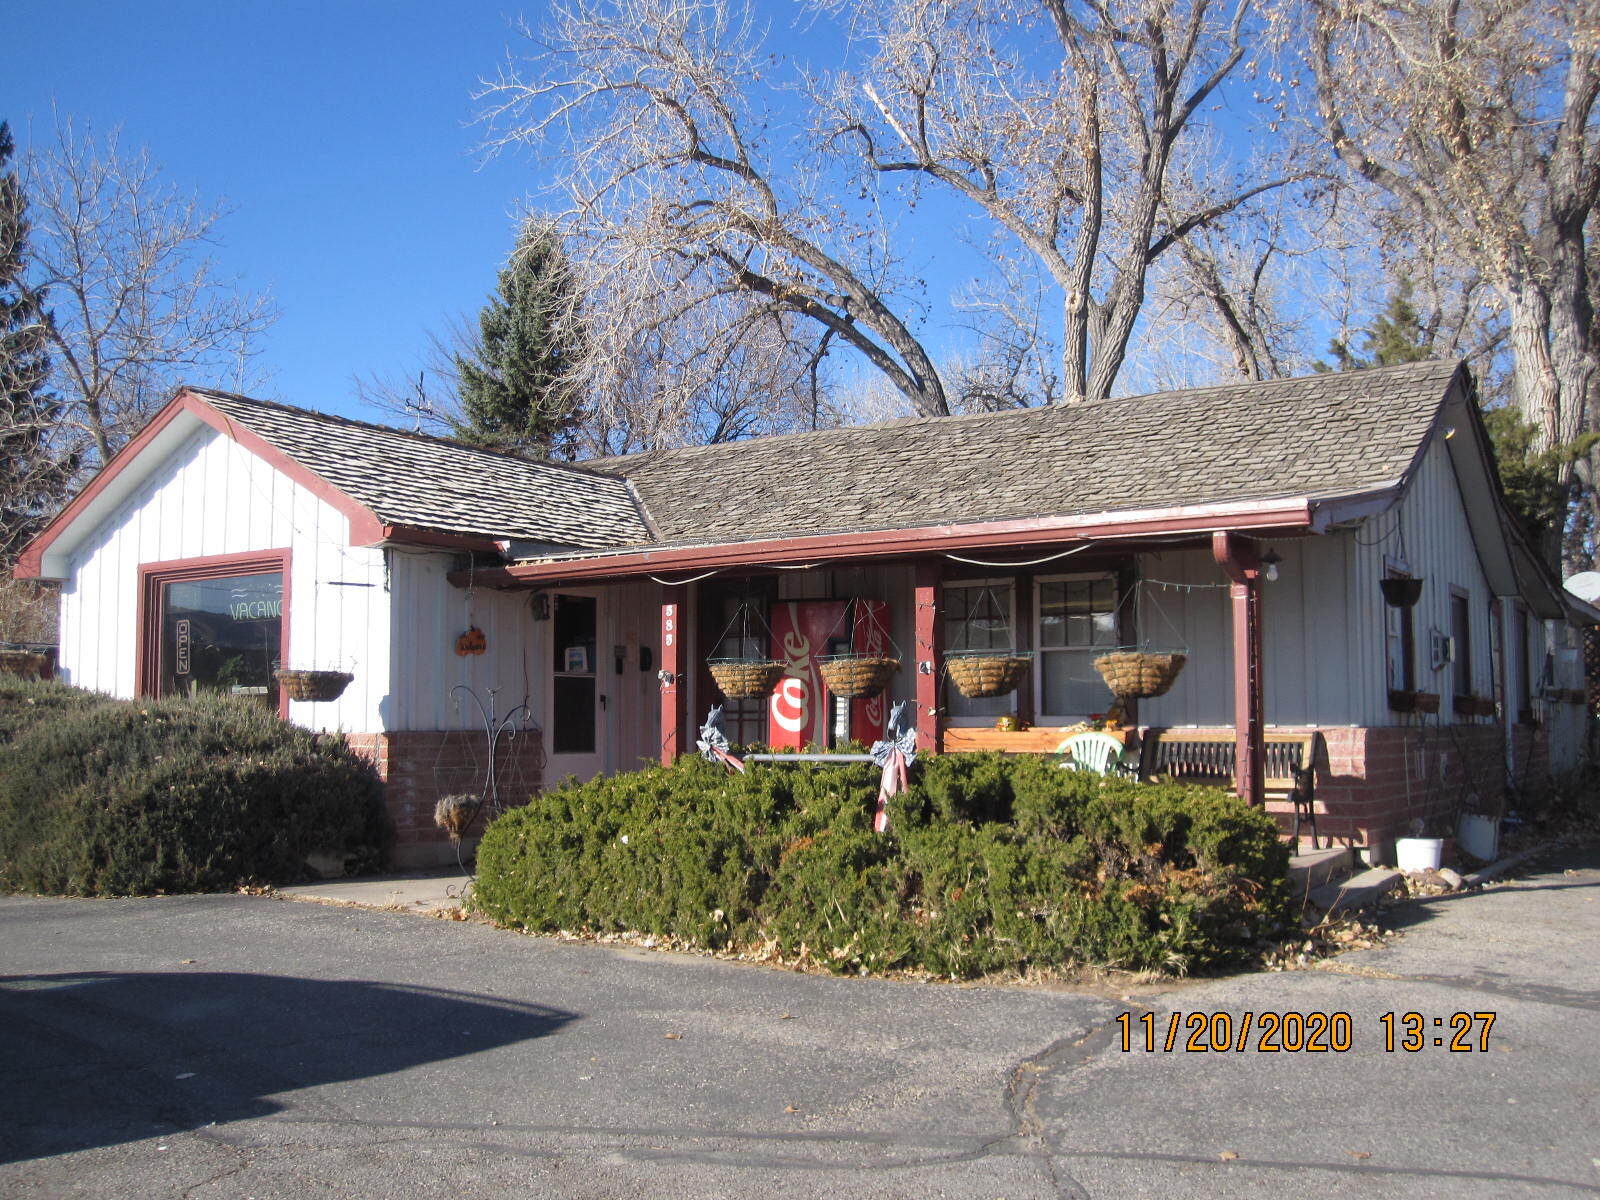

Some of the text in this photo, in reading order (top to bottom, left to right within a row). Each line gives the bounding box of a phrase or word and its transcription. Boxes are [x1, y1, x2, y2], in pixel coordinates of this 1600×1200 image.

[230, 600, 283, 620] VACANC
[665, 604, 673, 647] 585
[178, 623, 188, 671] OPEN
[771, 630, 811, 732] Coke
